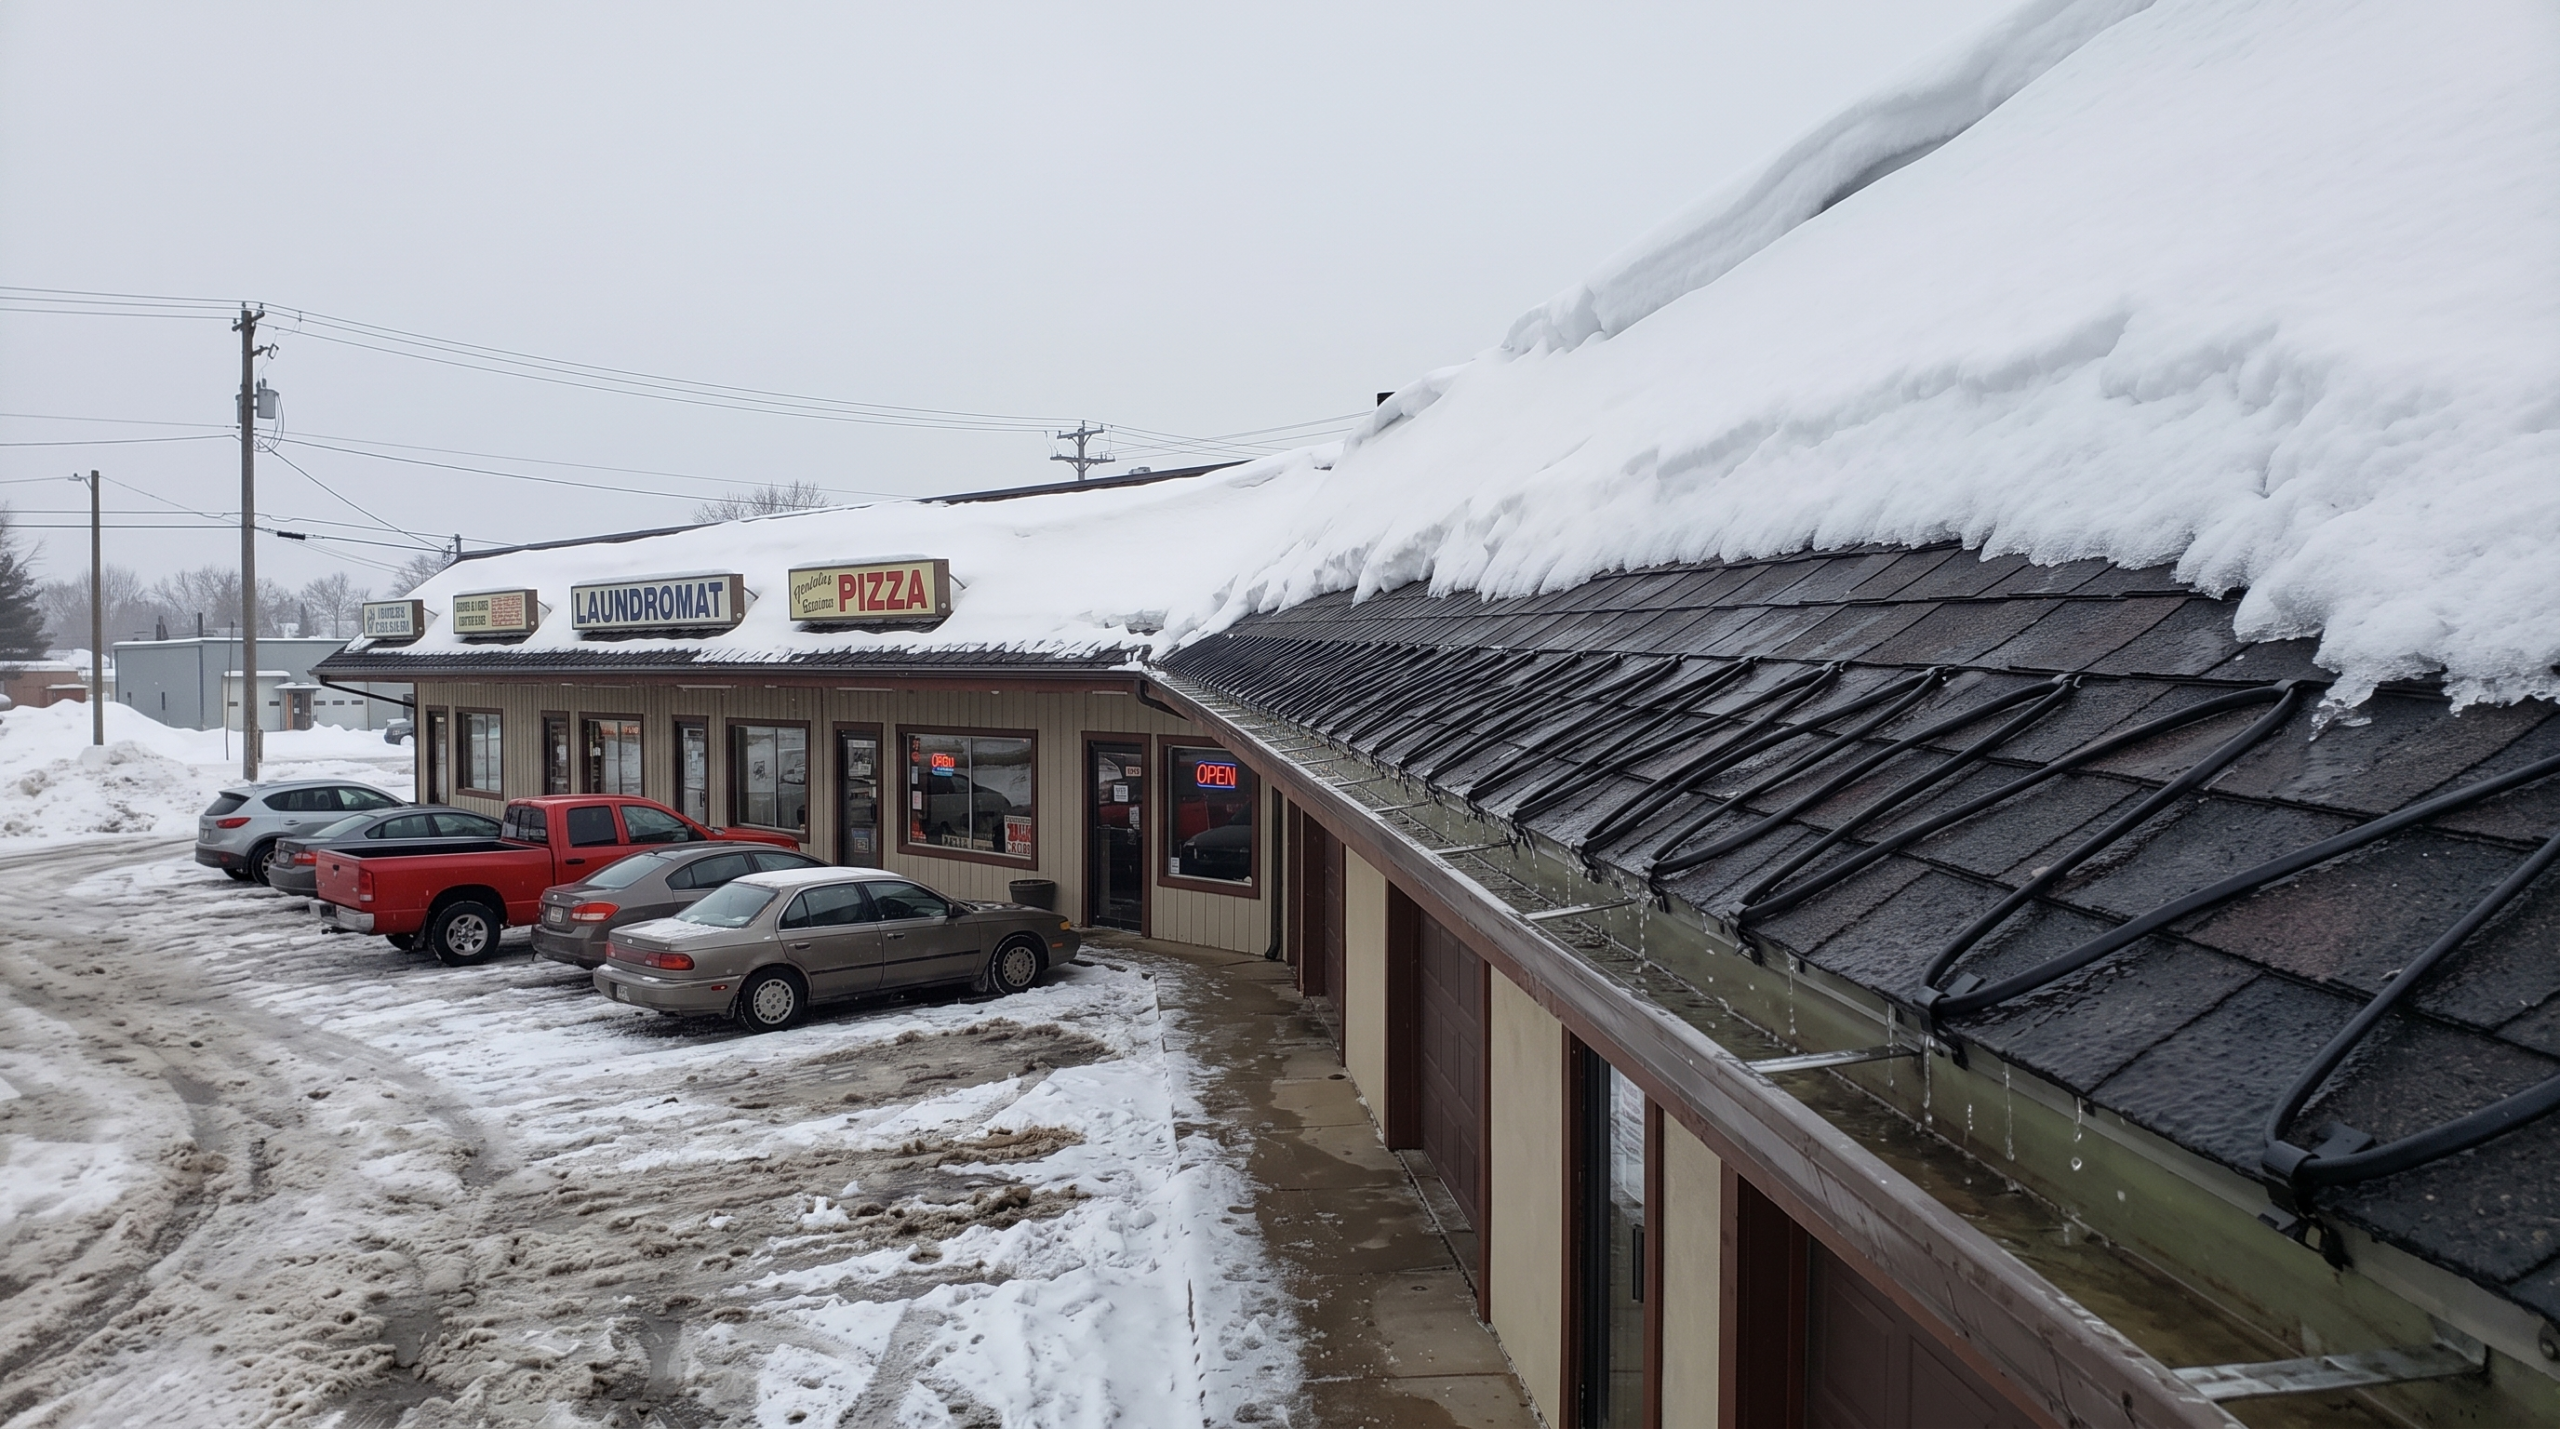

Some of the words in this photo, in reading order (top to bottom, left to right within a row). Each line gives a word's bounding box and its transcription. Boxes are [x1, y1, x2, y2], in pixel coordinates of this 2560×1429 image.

[575, 581, 724, 624] LAUNDROMAT
[838, 569, 928, 612] PIZZA
[1196, 763, 1236, 786] OPEN
